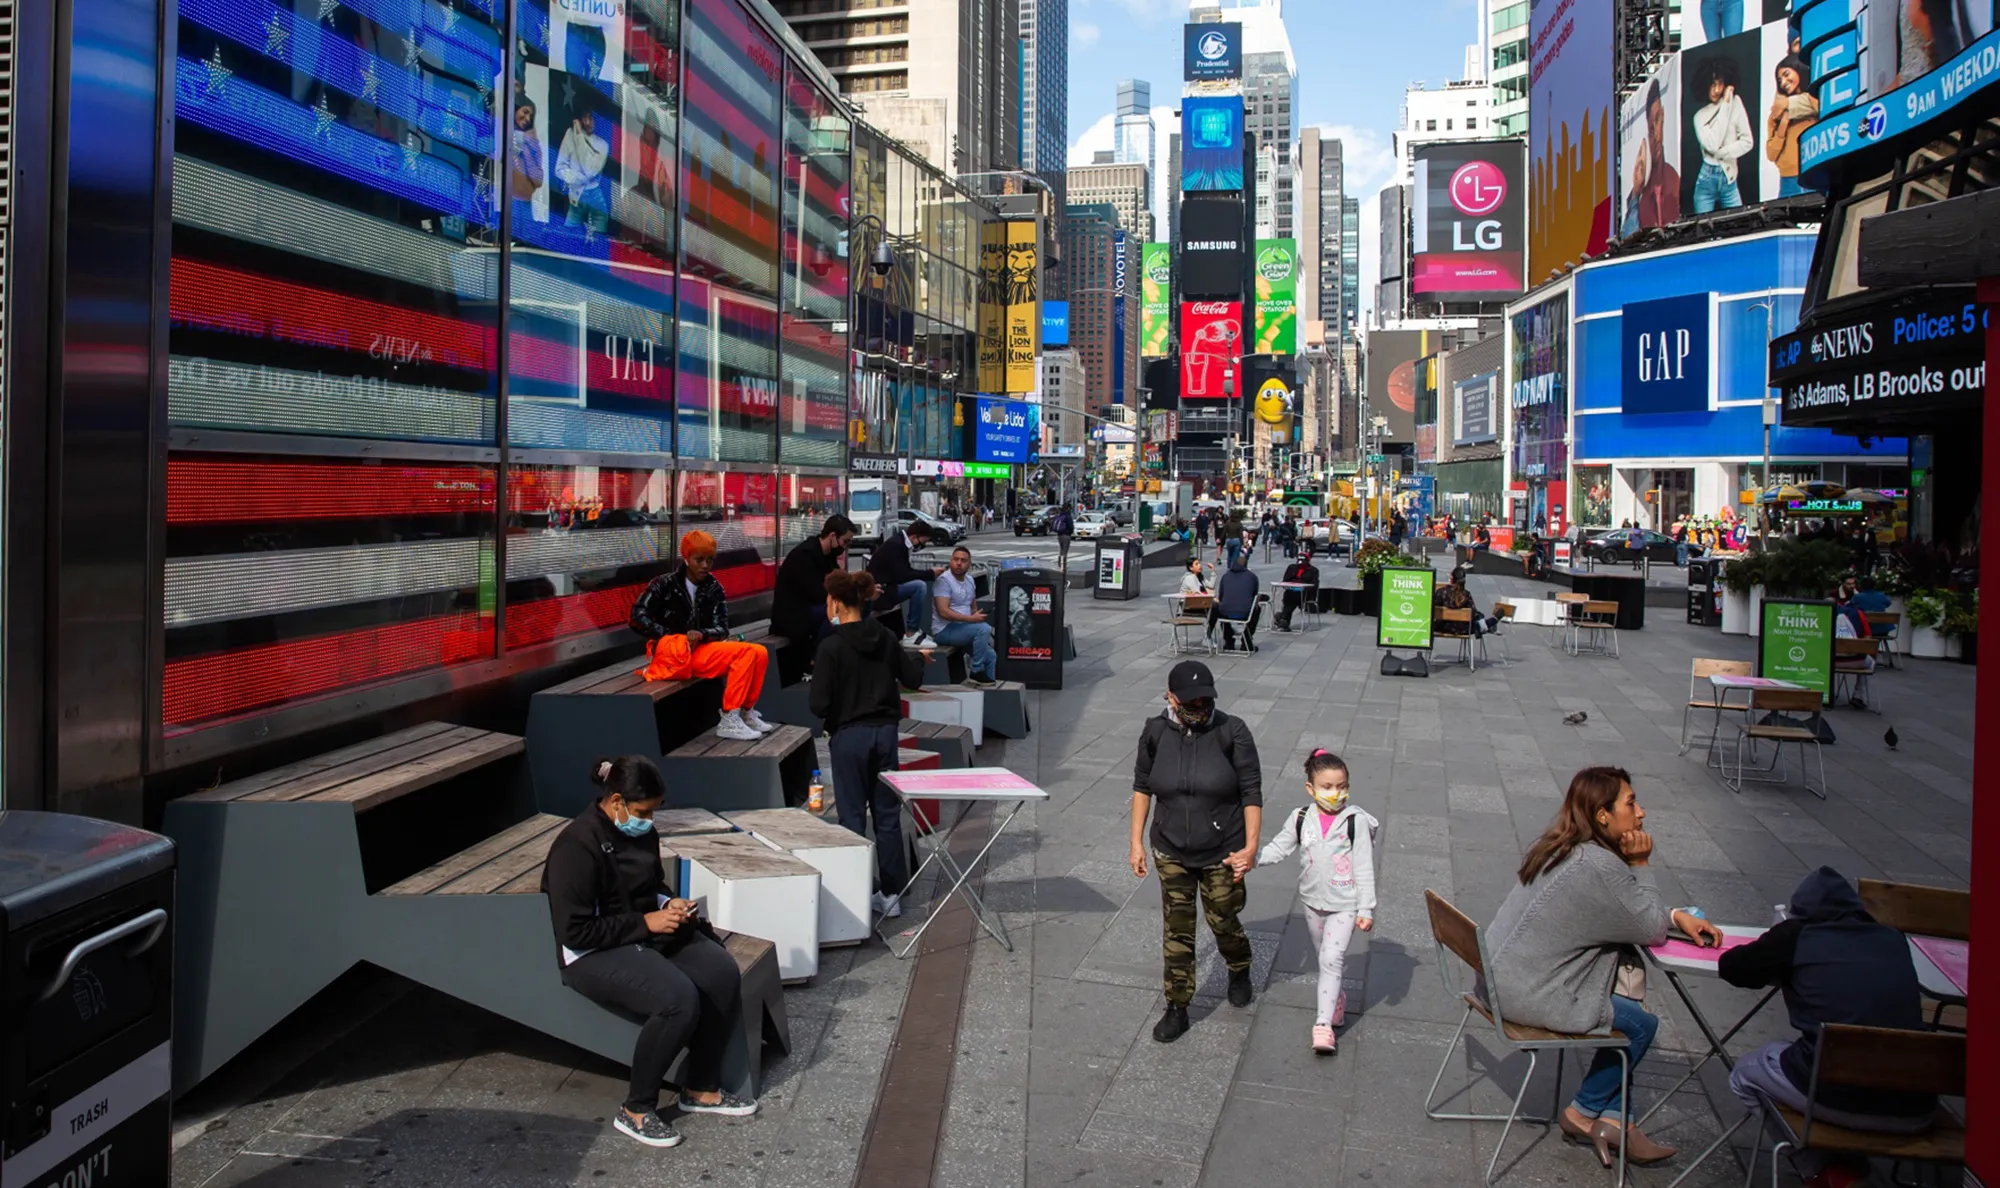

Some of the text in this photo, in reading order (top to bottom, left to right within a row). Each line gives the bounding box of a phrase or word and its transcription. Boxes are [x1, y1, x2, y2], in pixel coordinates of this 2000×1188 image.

[1196, 60, 1230, 68] Prudential
[1453, 219, 1503, 251] LG
[1187, 241, 1237, 250] SAMSUNG
[1455, 269, 1497, 277] www.LG.com
[1012, 326, 1028, 336] THE
[1823, 322, 1874, 361] NEWS
[1894, 313, 1955, 345] Police:
[1961, 303, 1976, 334] 5
[1638, 328, 1690, 382] GAP
[1513, 379, 1530, 409] OLD
[1530, 372, 1556, 406] NAVY
[1805, 380, 1850, 408] Adams,
[1854, 373, 1874, 401] LB
[1879, 365, 1944, 398] Brooks
[852, 458, 897, 471] SKECHERS
[1807, 500, 1831, 509] HOT
[1393, 579, 1424, 589] THINK
[1777, 616, 1820, 629] THINK
[70, 1098, 109, 1135] TRASH
[46, 1144, 113, 1188] ON'T
